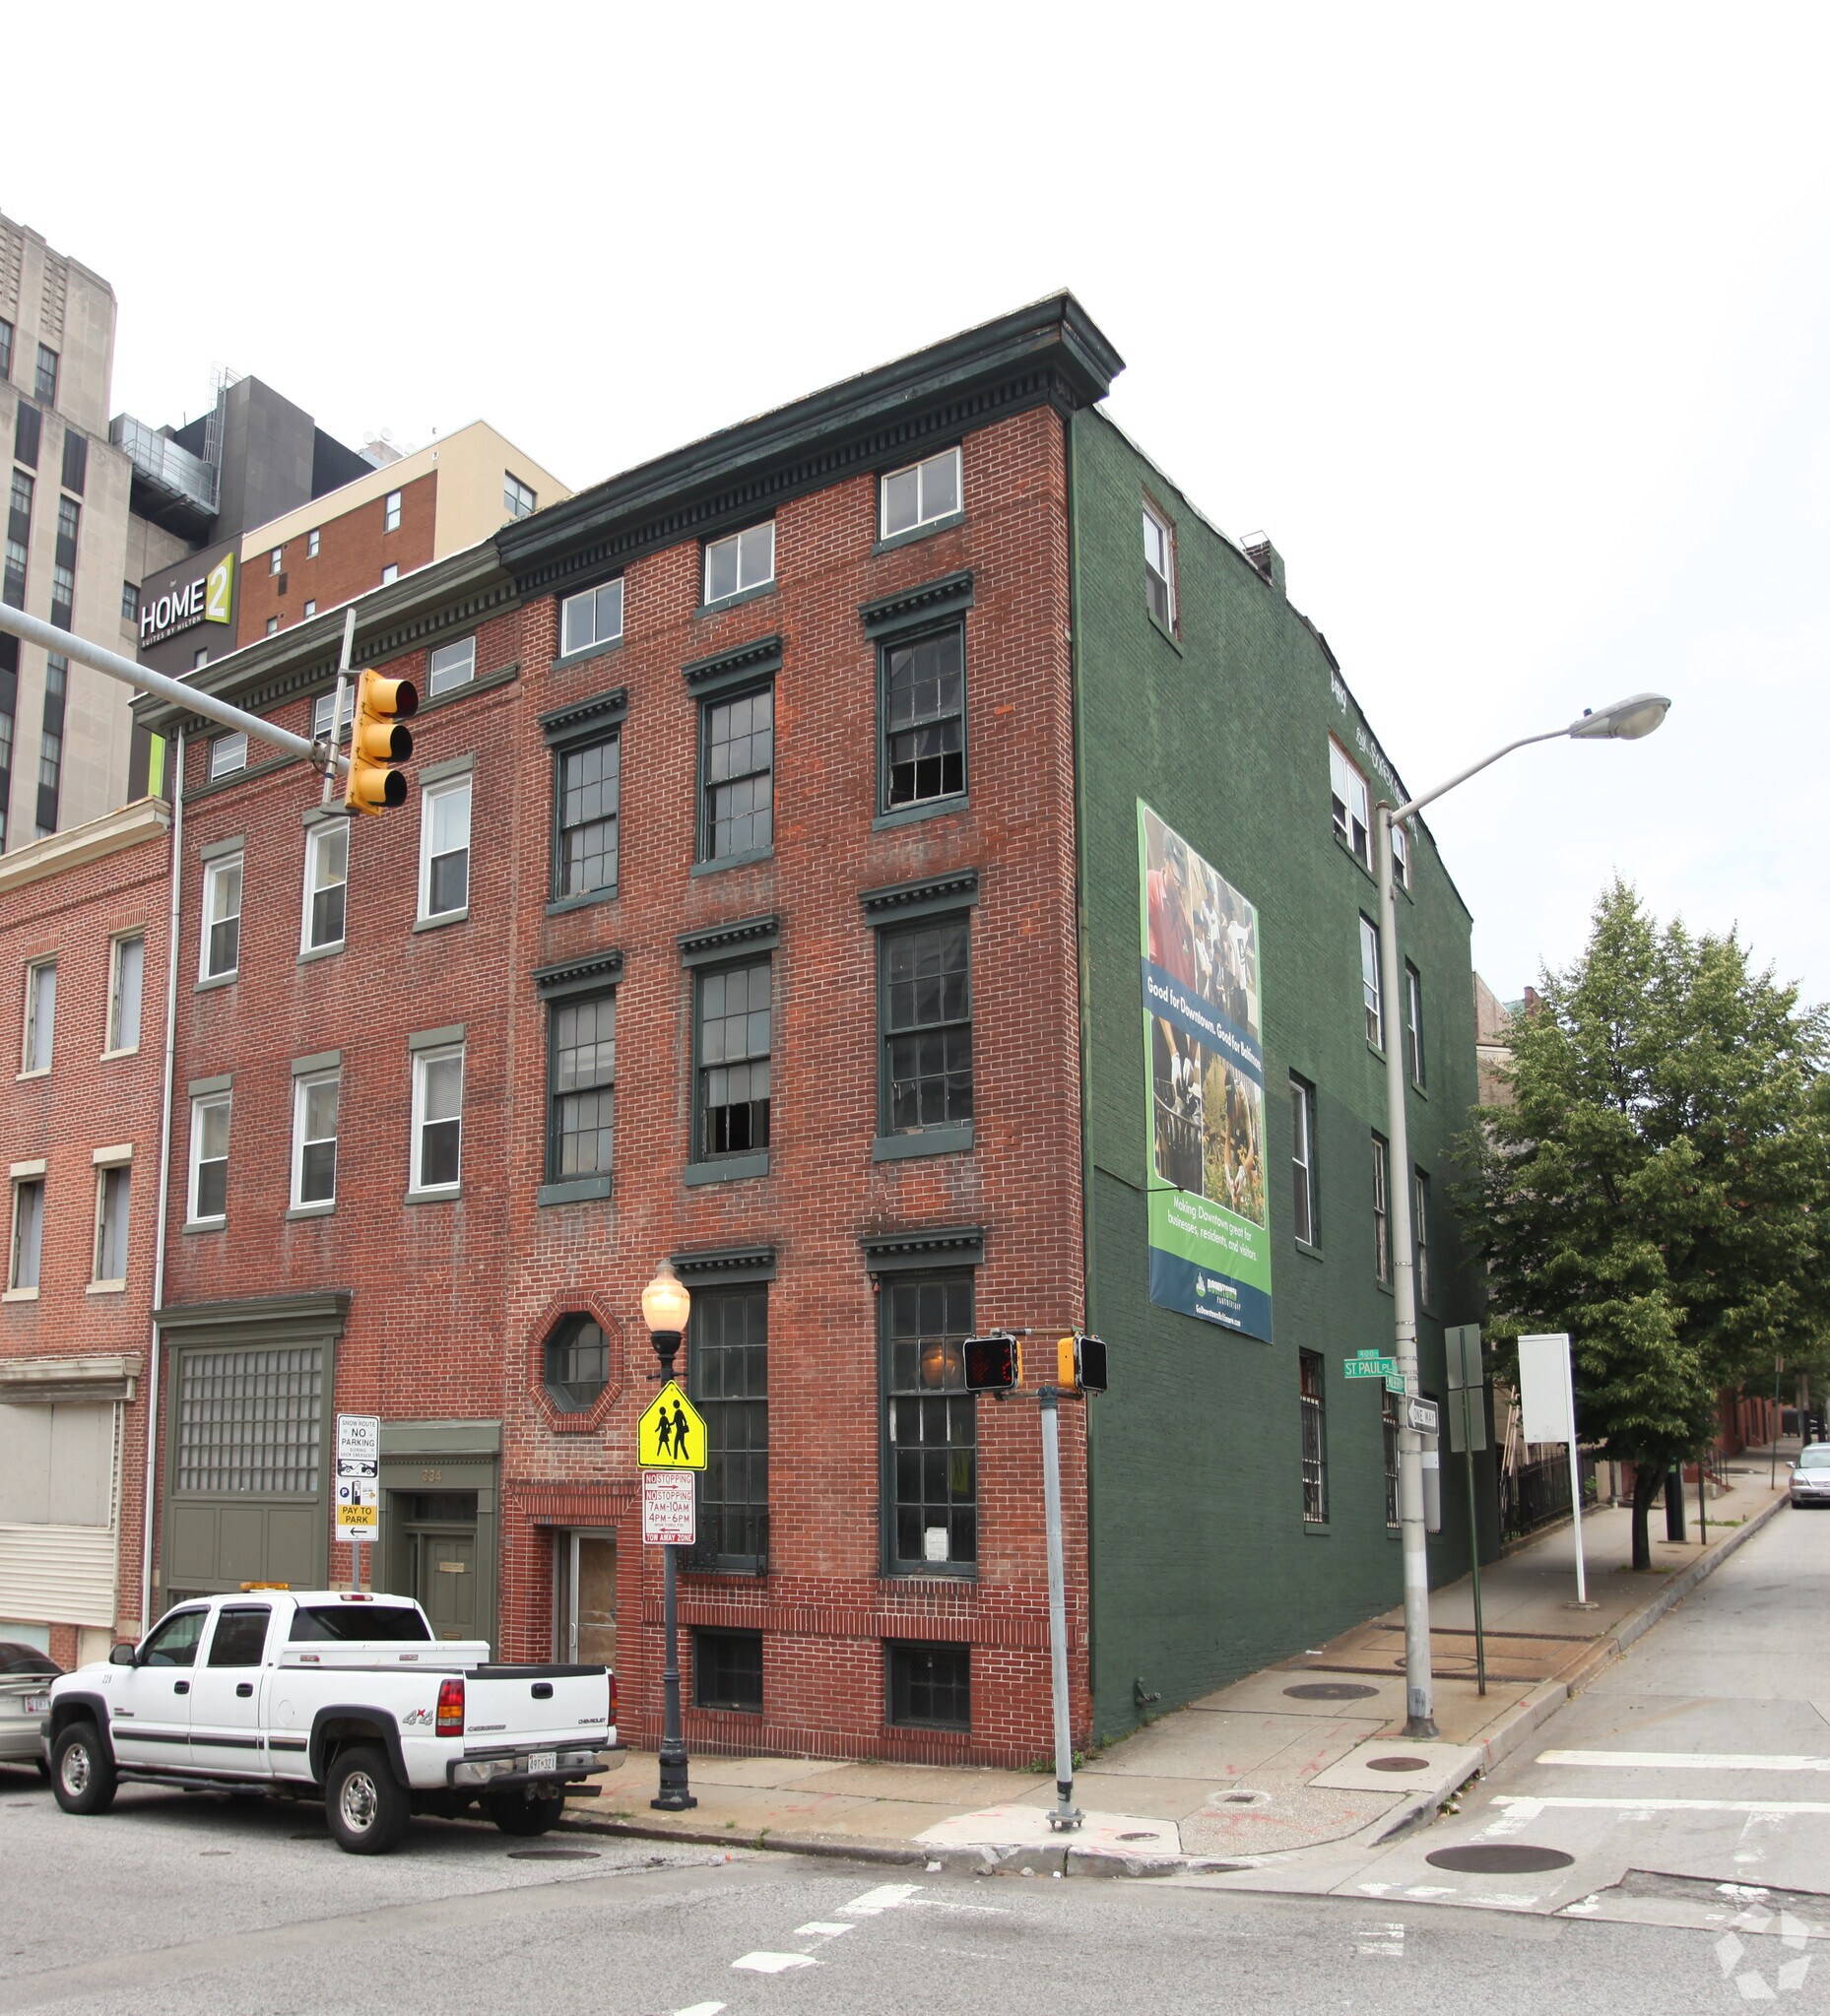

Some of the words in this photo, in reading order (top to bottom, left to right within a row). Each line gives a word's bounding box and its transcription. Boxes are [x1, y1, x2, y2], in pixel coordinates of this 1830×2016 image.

[141, 578, 205, 638] HOME
[208, 565, 228, 618] 2
[142, 631, 164, 647] SUITES
[177, 616, 201, 629] HILTON
[1147, 976, 1168, 1002] Good
[1170, 989, 1180, 1008] for
[1180, 997, 1216, 1035] Downtown.
[1216, 1023, 1231, 1047] Good
[1231, 1034, 1240, 1053] for
[1173, 1195, 1197, 1220] Making
[1198, 1205, 1228, 1230] Downtown
[1228, 1223, 1243, 1238] great
[1167, 1208, 1199, 1237] businesses,
[1200, 1228, 1227, 1249] residents,
[1228, 1241, 1239, 1252] and
[1239, 1243, 1257, 1261] visitors.
[1358, 1362, 1382, 1374] PAUL
[351, 1428, 366, 1438] NO
[341, 1439, 375, 1448] PARKING
[422, 1469, 441, 1482] 334
[646, 1474, 657, 1483] NO
[658, 1474, 691, 1483] STOPPING
[646, 1491, 657, 1500] NO
[658, 1491, 691, 1500] STOPPING
[648, 1502, 689, 1512] 7AM-10AM
